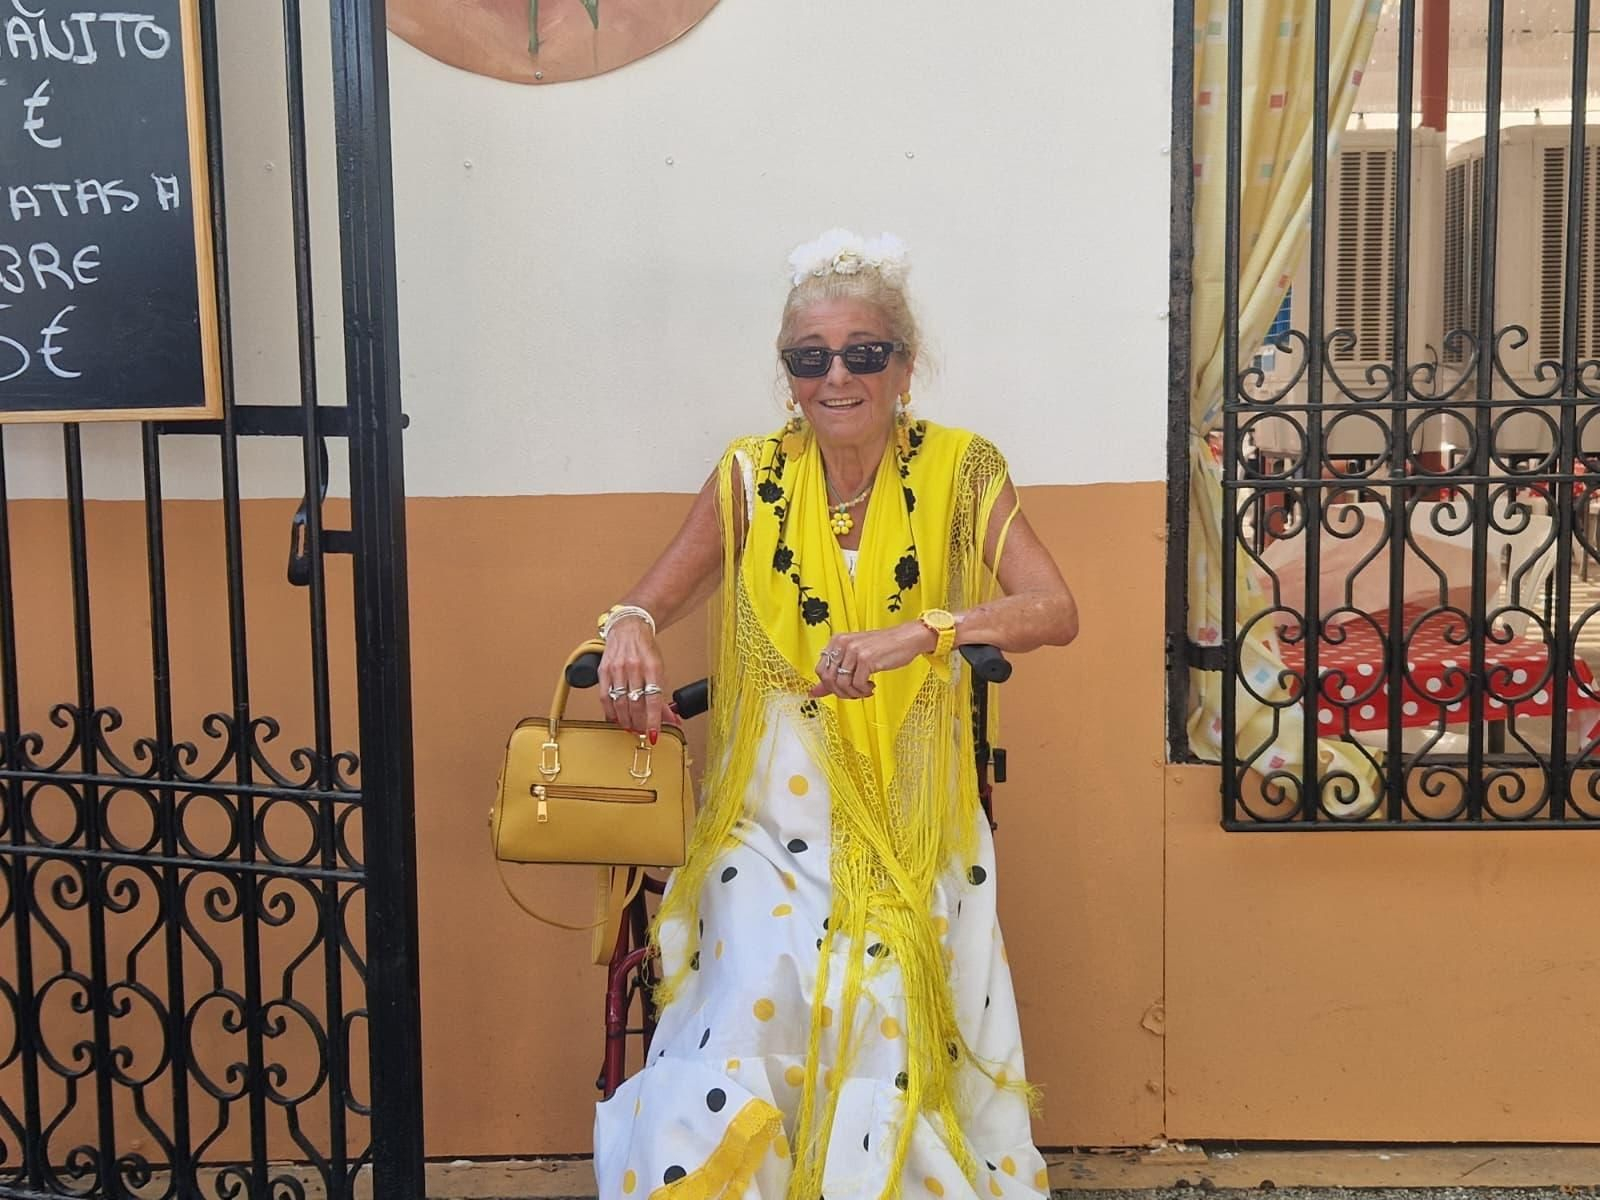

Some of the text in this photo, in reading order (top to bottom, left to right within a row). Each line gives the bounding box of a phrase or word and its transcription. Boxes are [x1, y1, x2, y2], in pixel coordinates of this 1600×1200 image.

[0, 12, 171, 64] ANITO
[0, 179, 140, 221] ATAS
[0, 242, 101, 293] BRE
